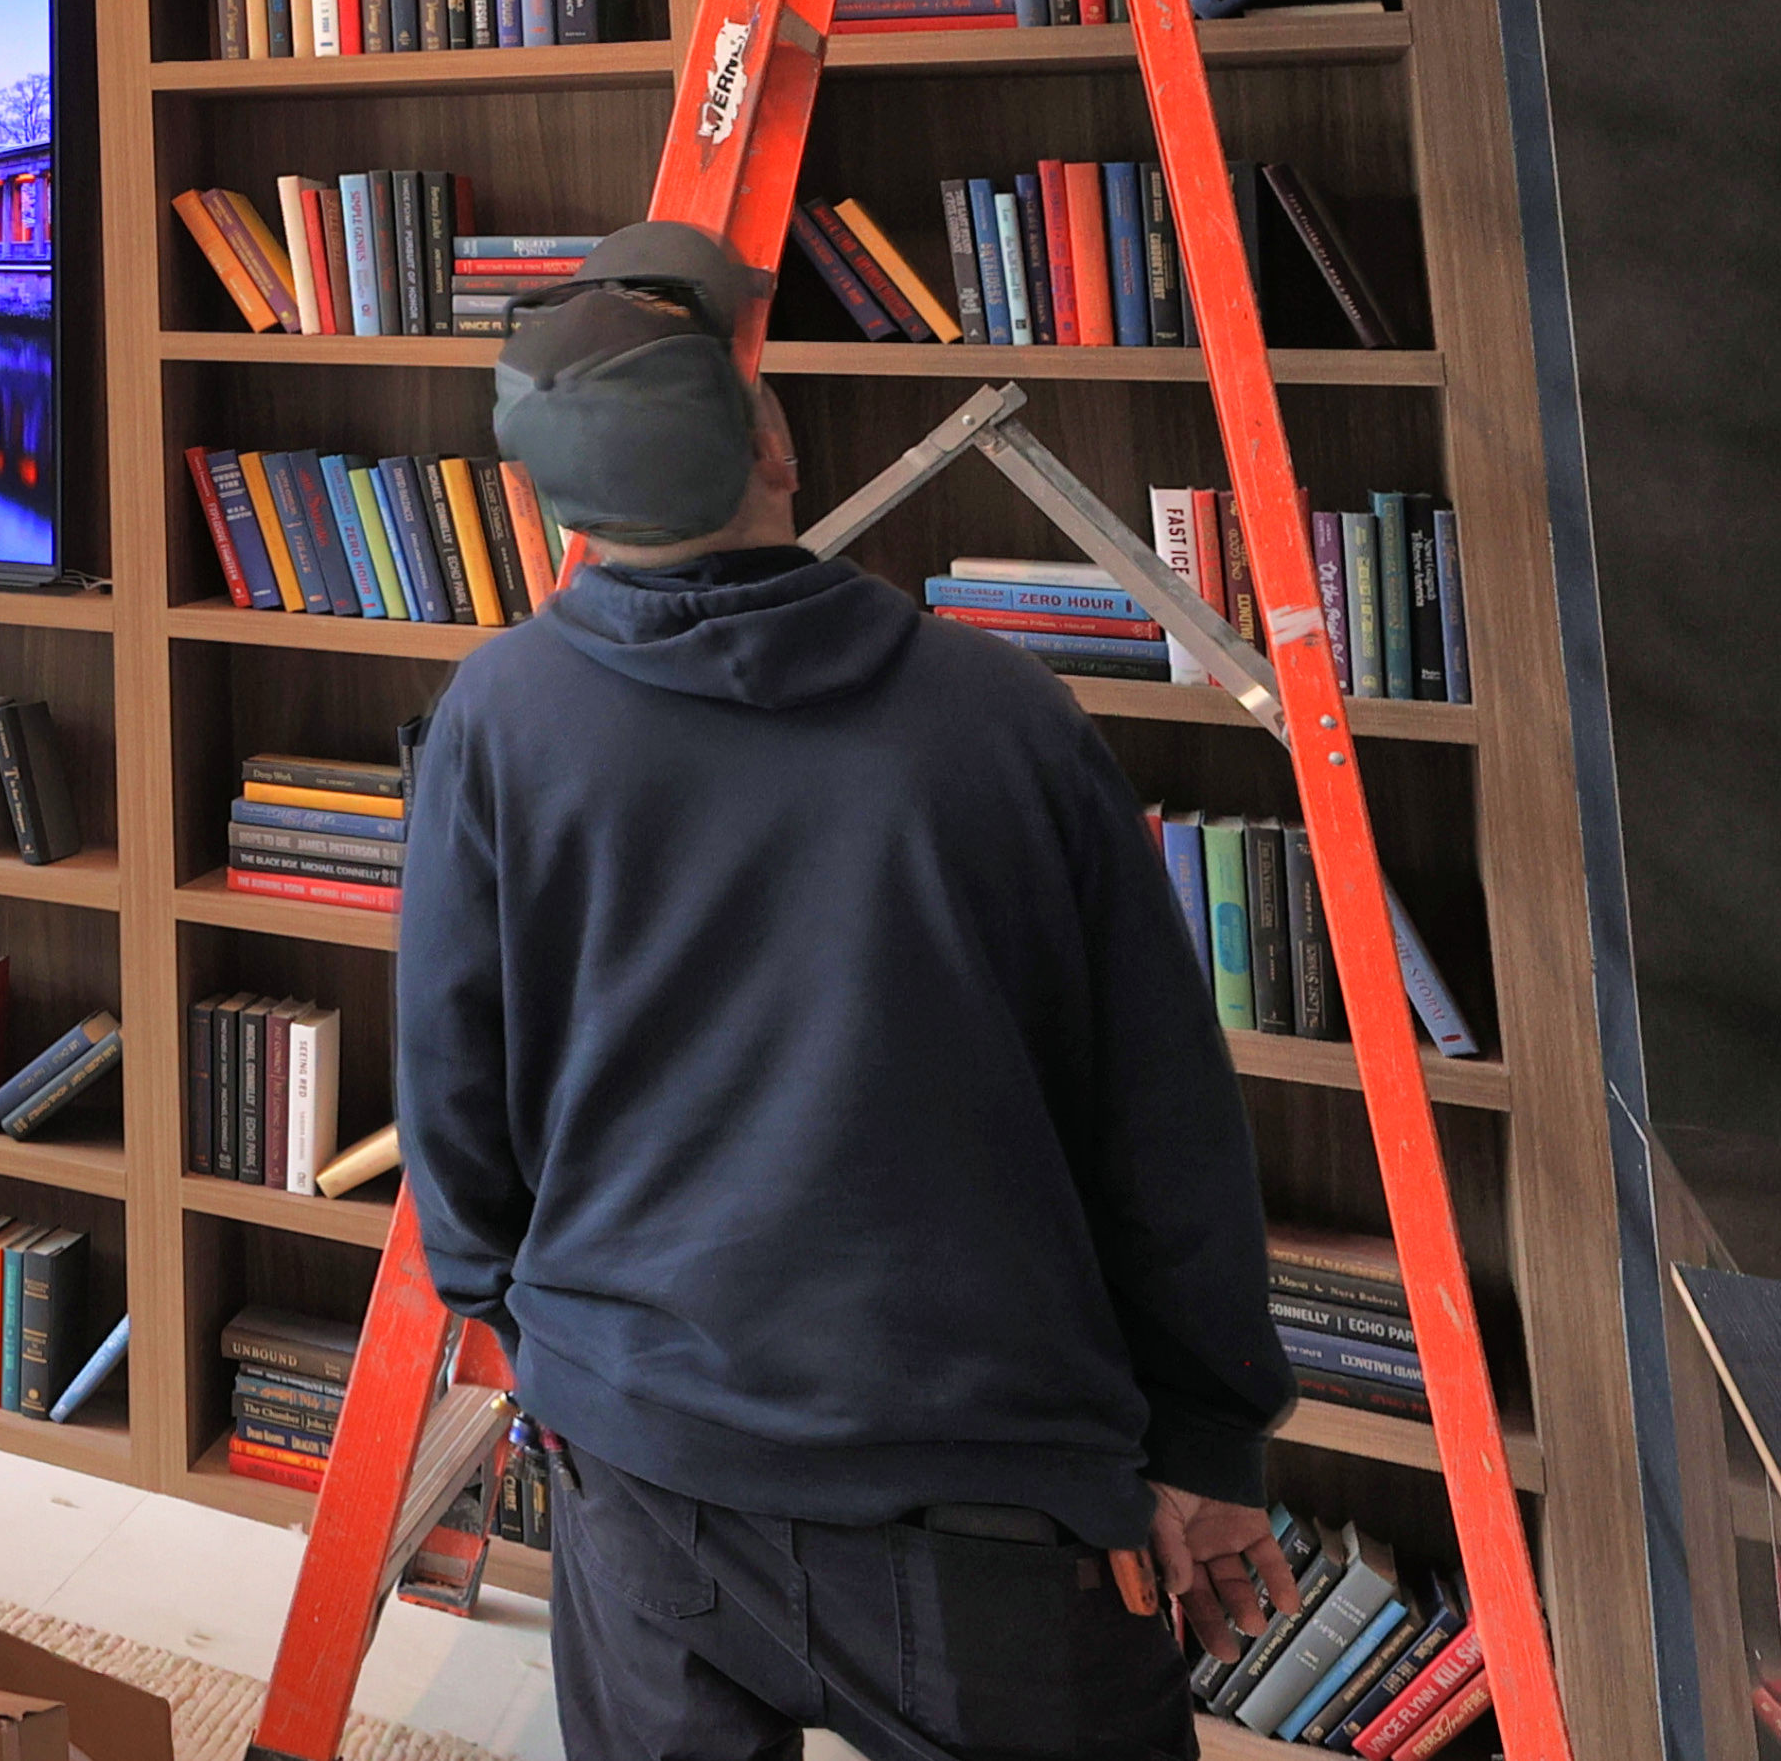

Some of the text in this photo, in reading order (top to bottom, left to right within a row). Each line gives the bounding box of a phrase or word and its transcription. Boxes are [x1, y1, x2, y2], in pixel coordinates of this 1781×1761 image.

[405, 230, 418, 319] PURSUIT OF HONOR
[427, 465, 452, 543] MICHAEL CONNELLY
[345, 526, 371, 595] ZERO HOUR
[1167, 508, 1189, 575] FAST ICE
[447, 556, 467, 605] ECHO PARK
[1019, 592, 1114, 612] ZERO HOUR
[240, 854, 297, 869] THE BLACK BOX
[301, 861, 381, 880] MICHAEL CONNELLY
[329, 842, 380, 859] PATTERSON
[244, 1023, 256, 1108] MICHAEL CONNELLY
[298, 1039, 308, 1076] SEEING
[244, 1115, 255, 1168] ECHO PARK
[1349, 1320, 1384, 1338] ECHO
[232, 1342, 298, 1367] UNBOUND
[1431, 1662, 1466, 1689] KILL
[1365, 1687, 1439, 1754] VINCE FLYNN
